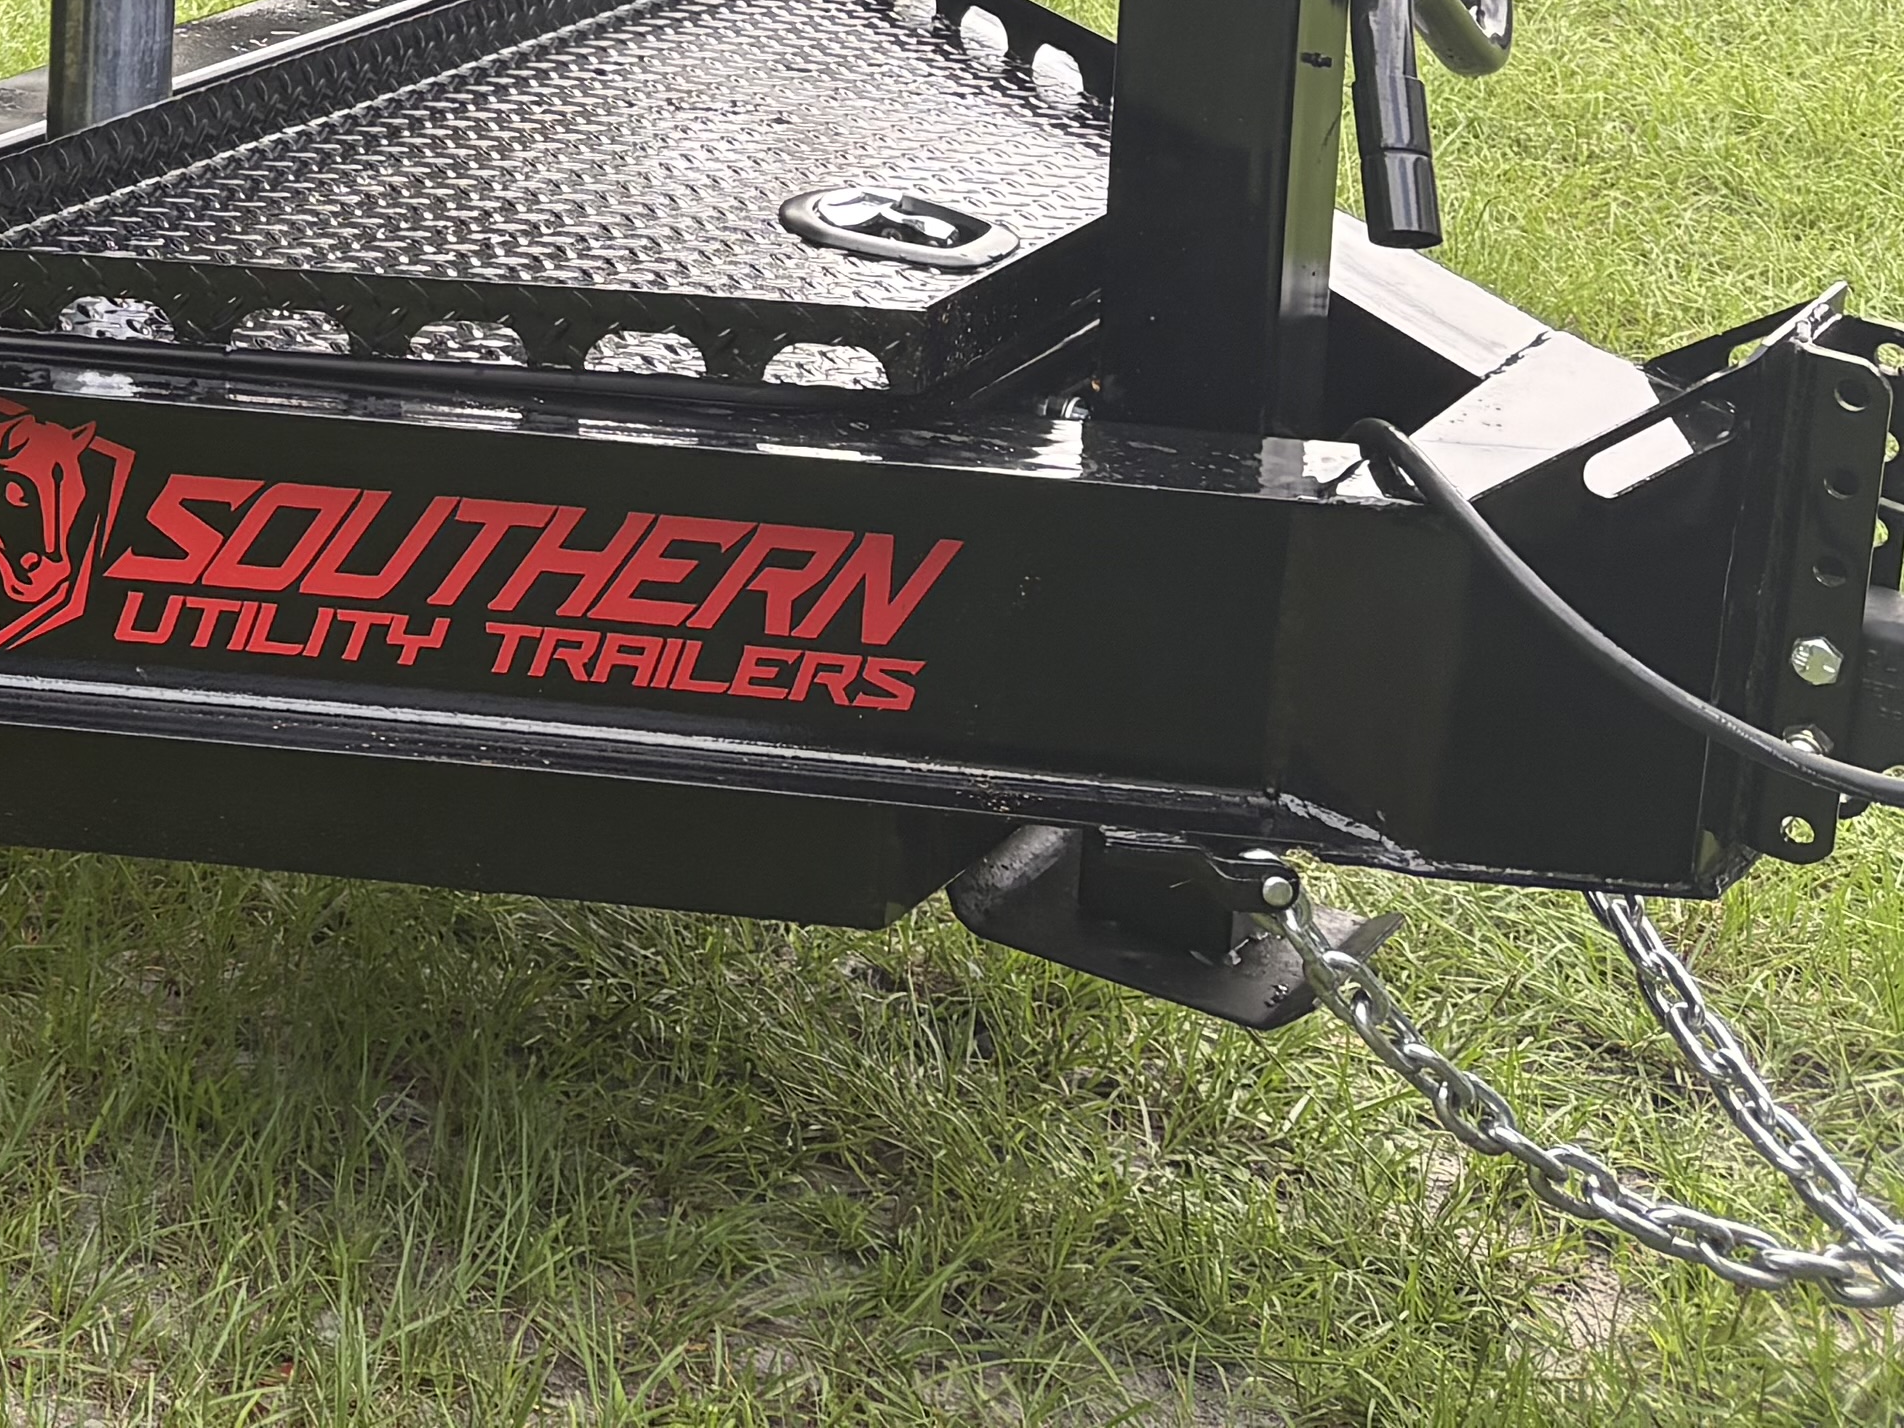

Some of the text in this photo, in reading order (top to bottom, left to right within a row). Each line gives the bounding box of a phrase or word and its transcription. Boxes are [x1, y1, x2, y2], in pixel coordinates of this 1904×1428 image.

[103, 473, 964, 646] SOUTHERN
[114, 590, 927, 712] UTILITY TRAILERS
